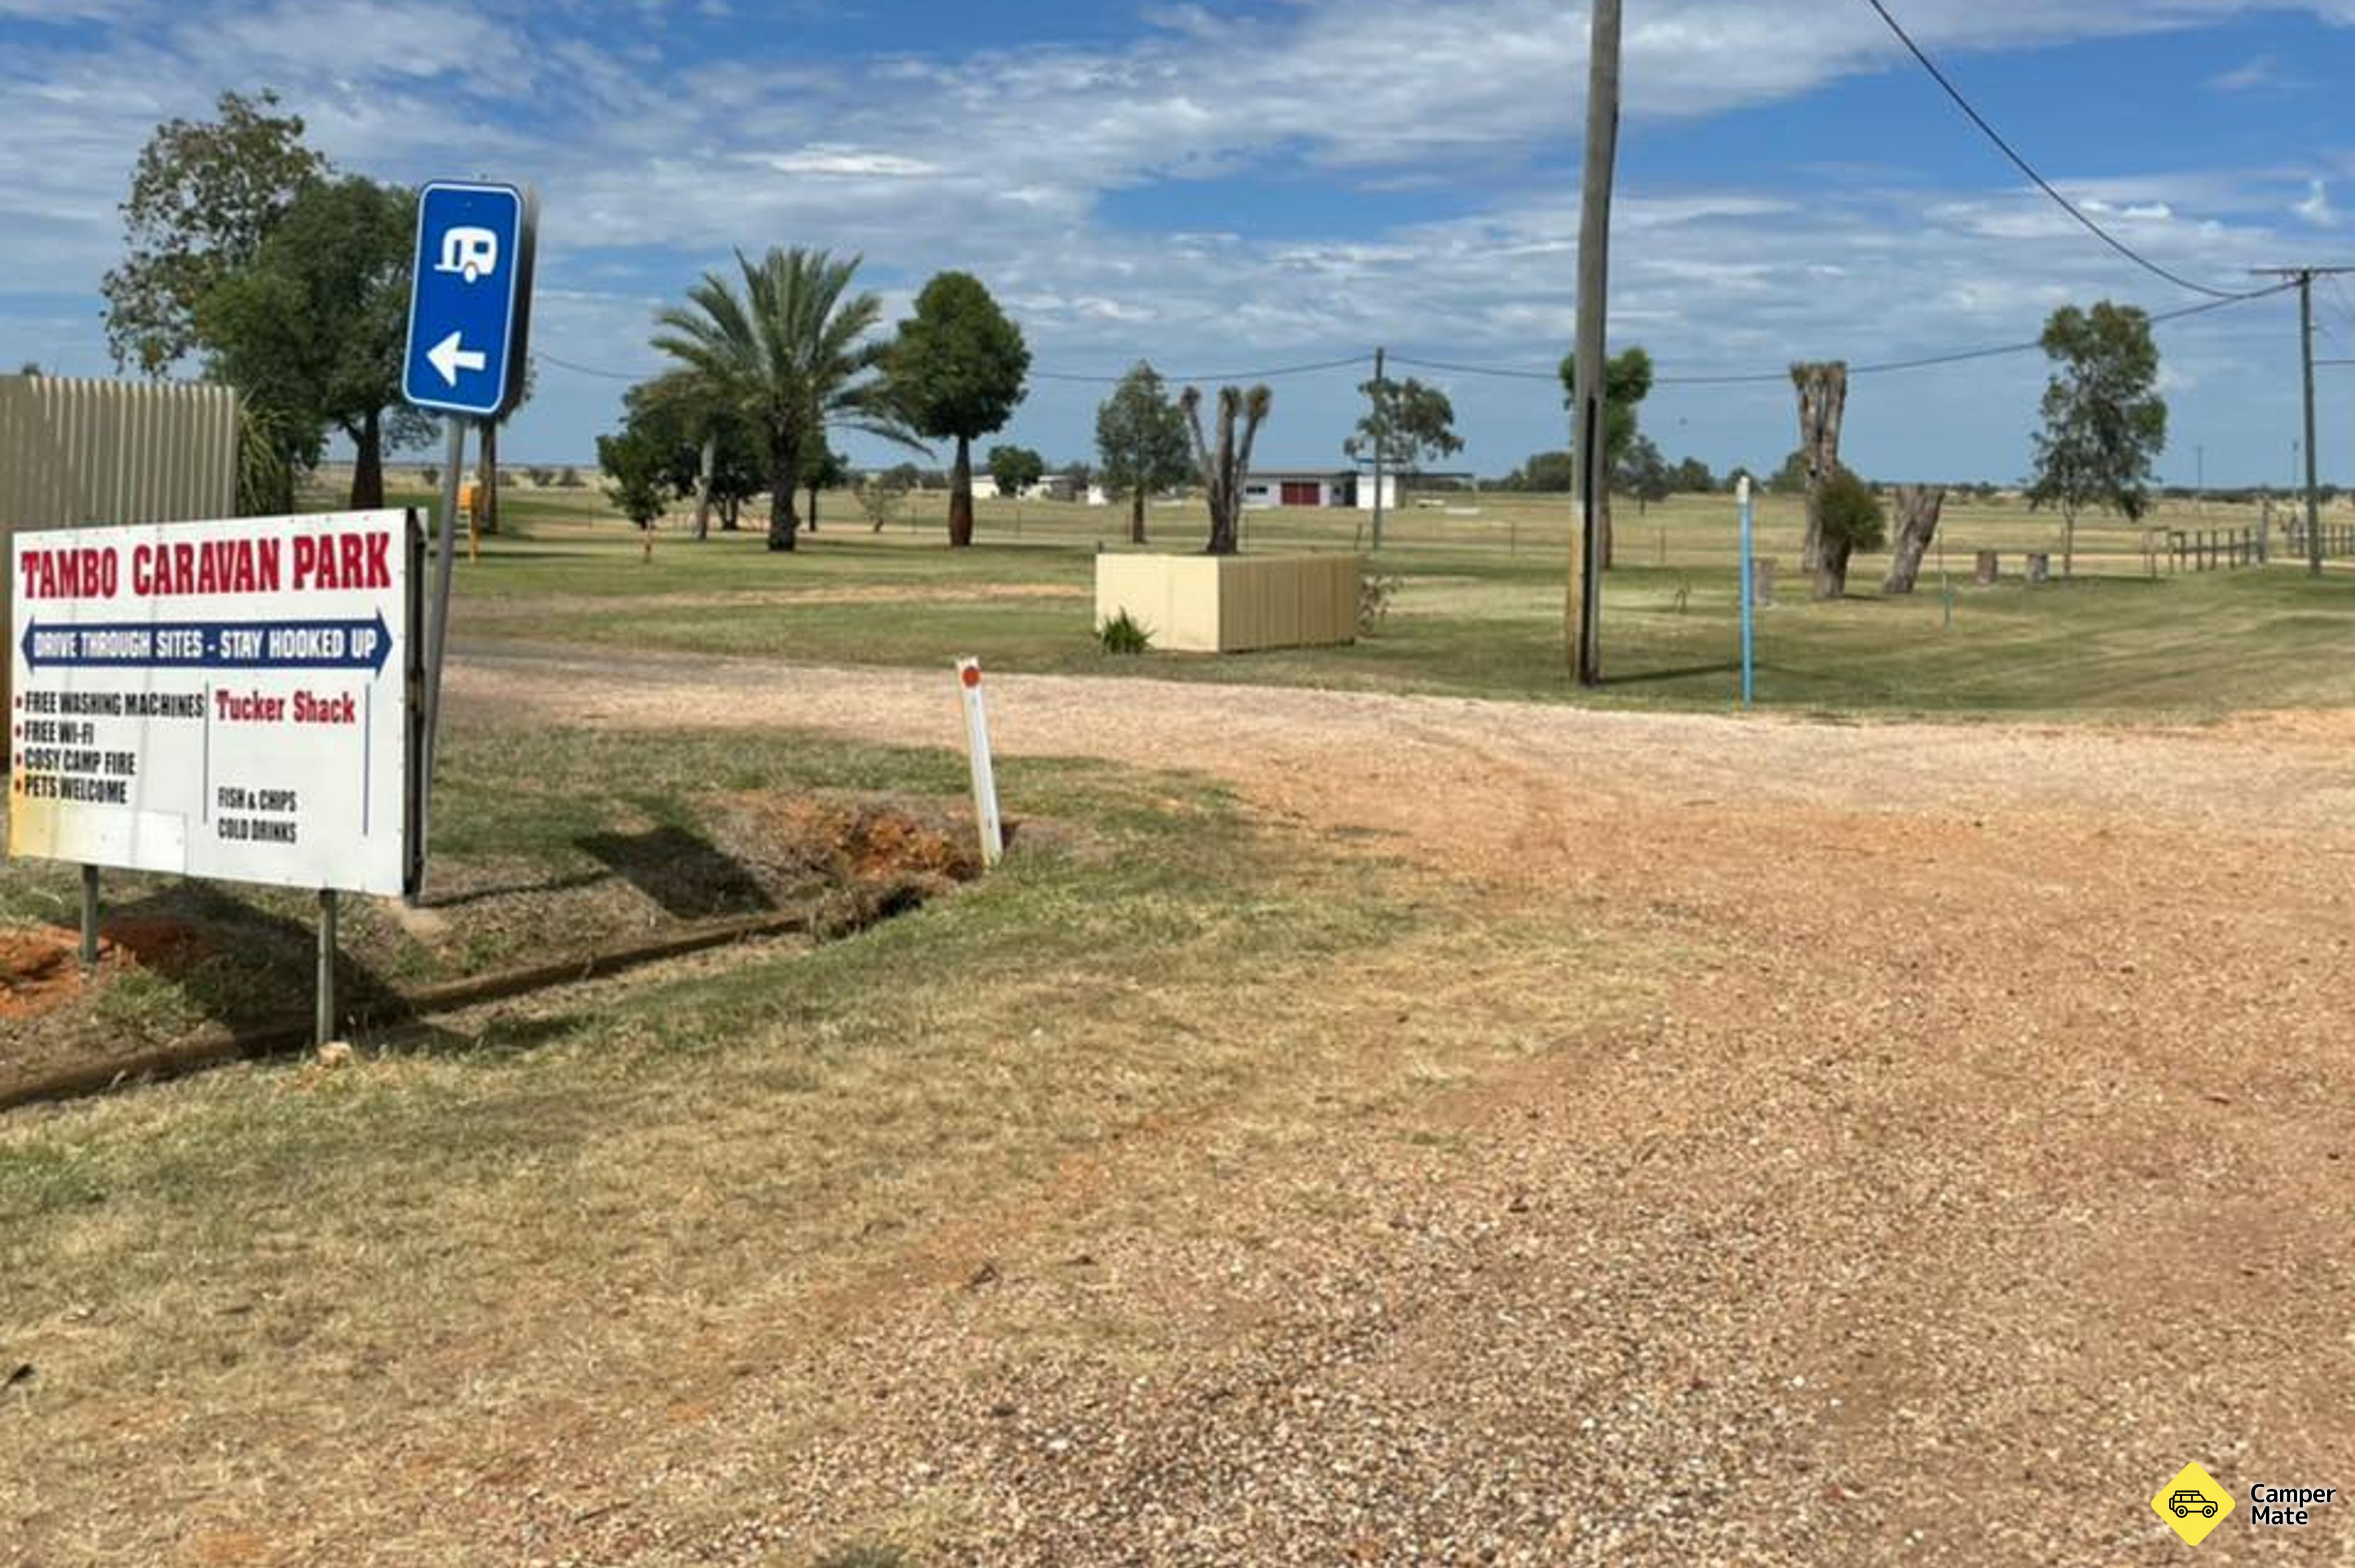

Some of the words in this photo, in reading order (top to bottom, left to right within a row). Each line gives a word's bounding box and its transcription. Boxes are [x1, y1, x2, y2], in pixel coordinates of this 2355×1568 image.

[21, 546, 117, 599] TAMBO
[133, 537, 280, 596] CARAVAN
[293, 531, 392, 589] PARK
[34, 632, 77, 658] DRIVE
[81, 630, 151, 658] THROUGH
[156, 629, 203, 658] SITES
[220, 630, 263, 658] STAY
[268, 629, 344, 658] HOOKED
[351, 627, 377, 658] UP
[25, 691, 57, 713] FREE
[59, 692, 121, 716] WASHING
[124, 692, 204, 718] MACHINES
[216, 689, 285, 721] Tucker
[293, 690, 356, 724] Shack
[24, 721, 56, 743] FREE
[59, 722, 94, 745] WI-FI
[24, 748, 61, 770] COSY
[62, 749, 101, 773] CAMP
[105, 751, 136, 776] FIRE
[24, 774, 57, 797] PETS
[59, 776, 127, 805] WELCOME
[218, 786, 245, 809] FISH
[248, 792, 255, 809] &
[259, 789, 296, 812] CHIPS
[218, 817, 248, 840] COLD
[251, 818, 296, 844] DRINKS
